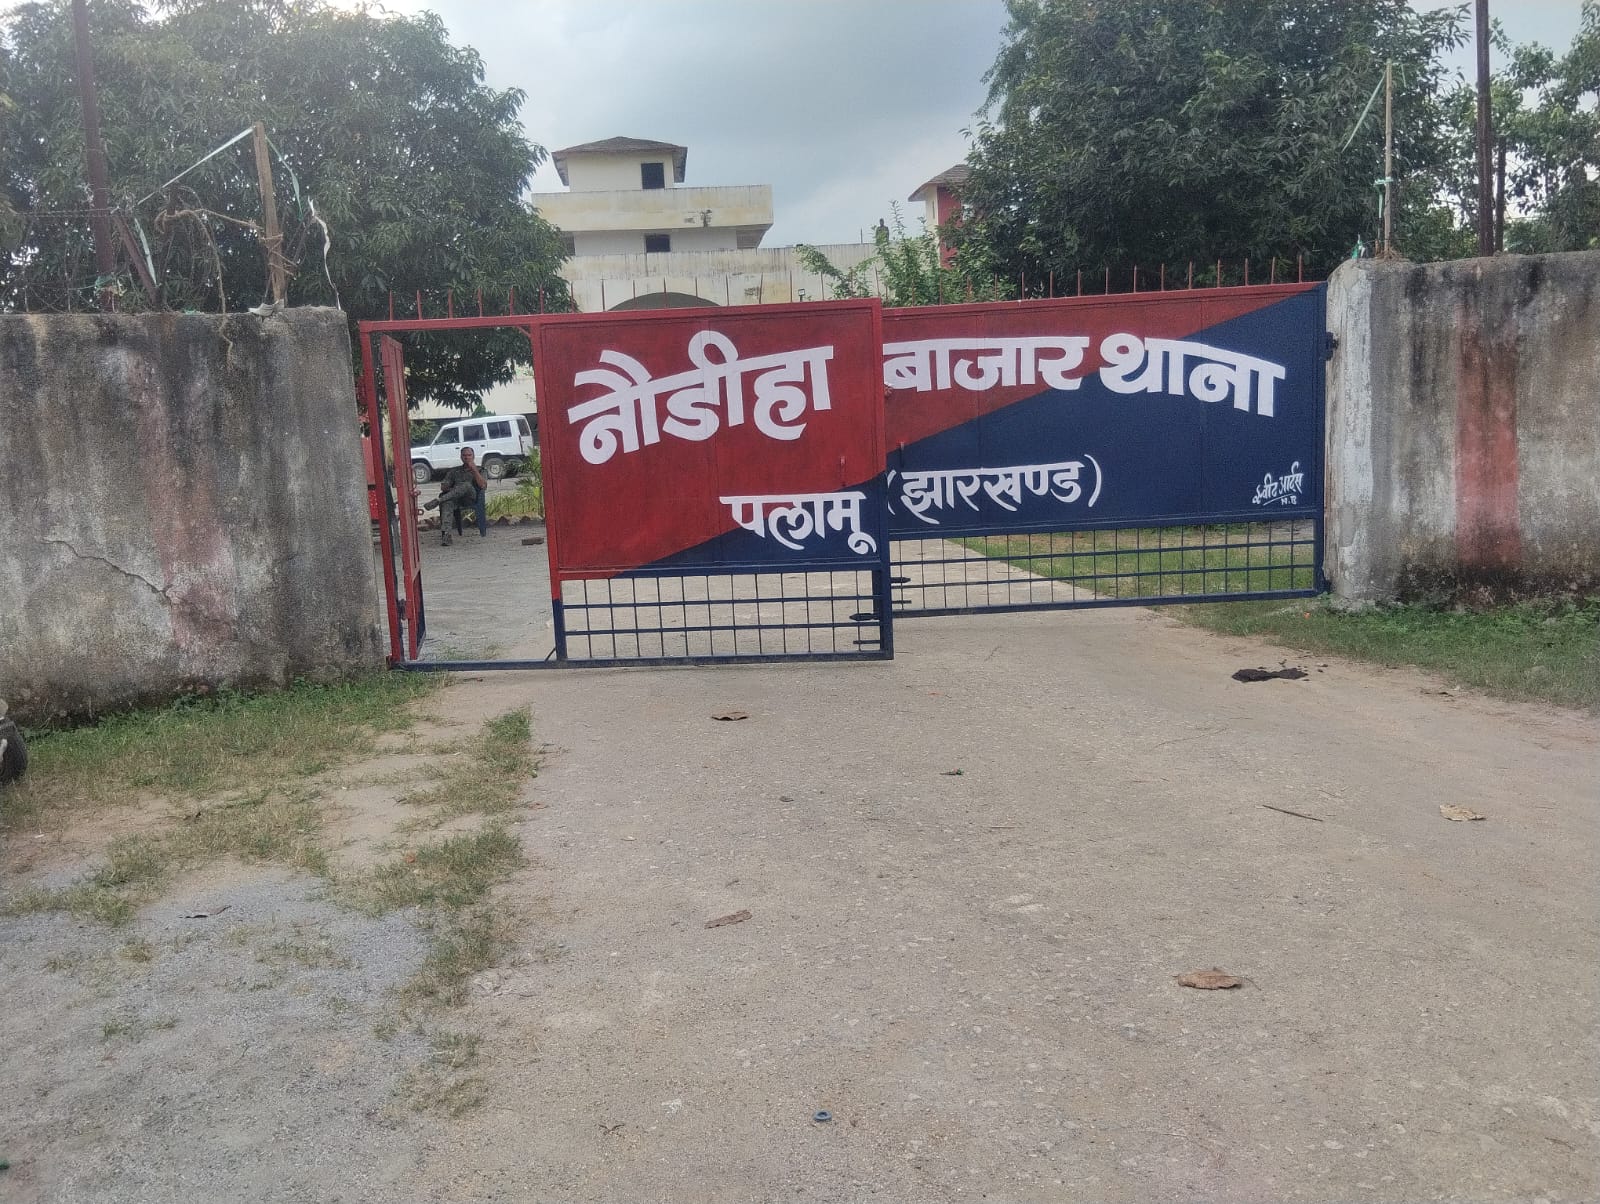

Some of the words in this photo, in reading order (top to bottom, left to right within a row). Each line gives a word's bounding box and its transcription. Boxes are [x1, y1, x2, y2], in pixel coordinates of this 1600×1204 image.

[568, 330, 833, 464] नौडीहा
[883, 336, 1090, 392] बाजार
[1099, 333, 1286, 417] थाना
[719, 491, 877, 554] पलामू
